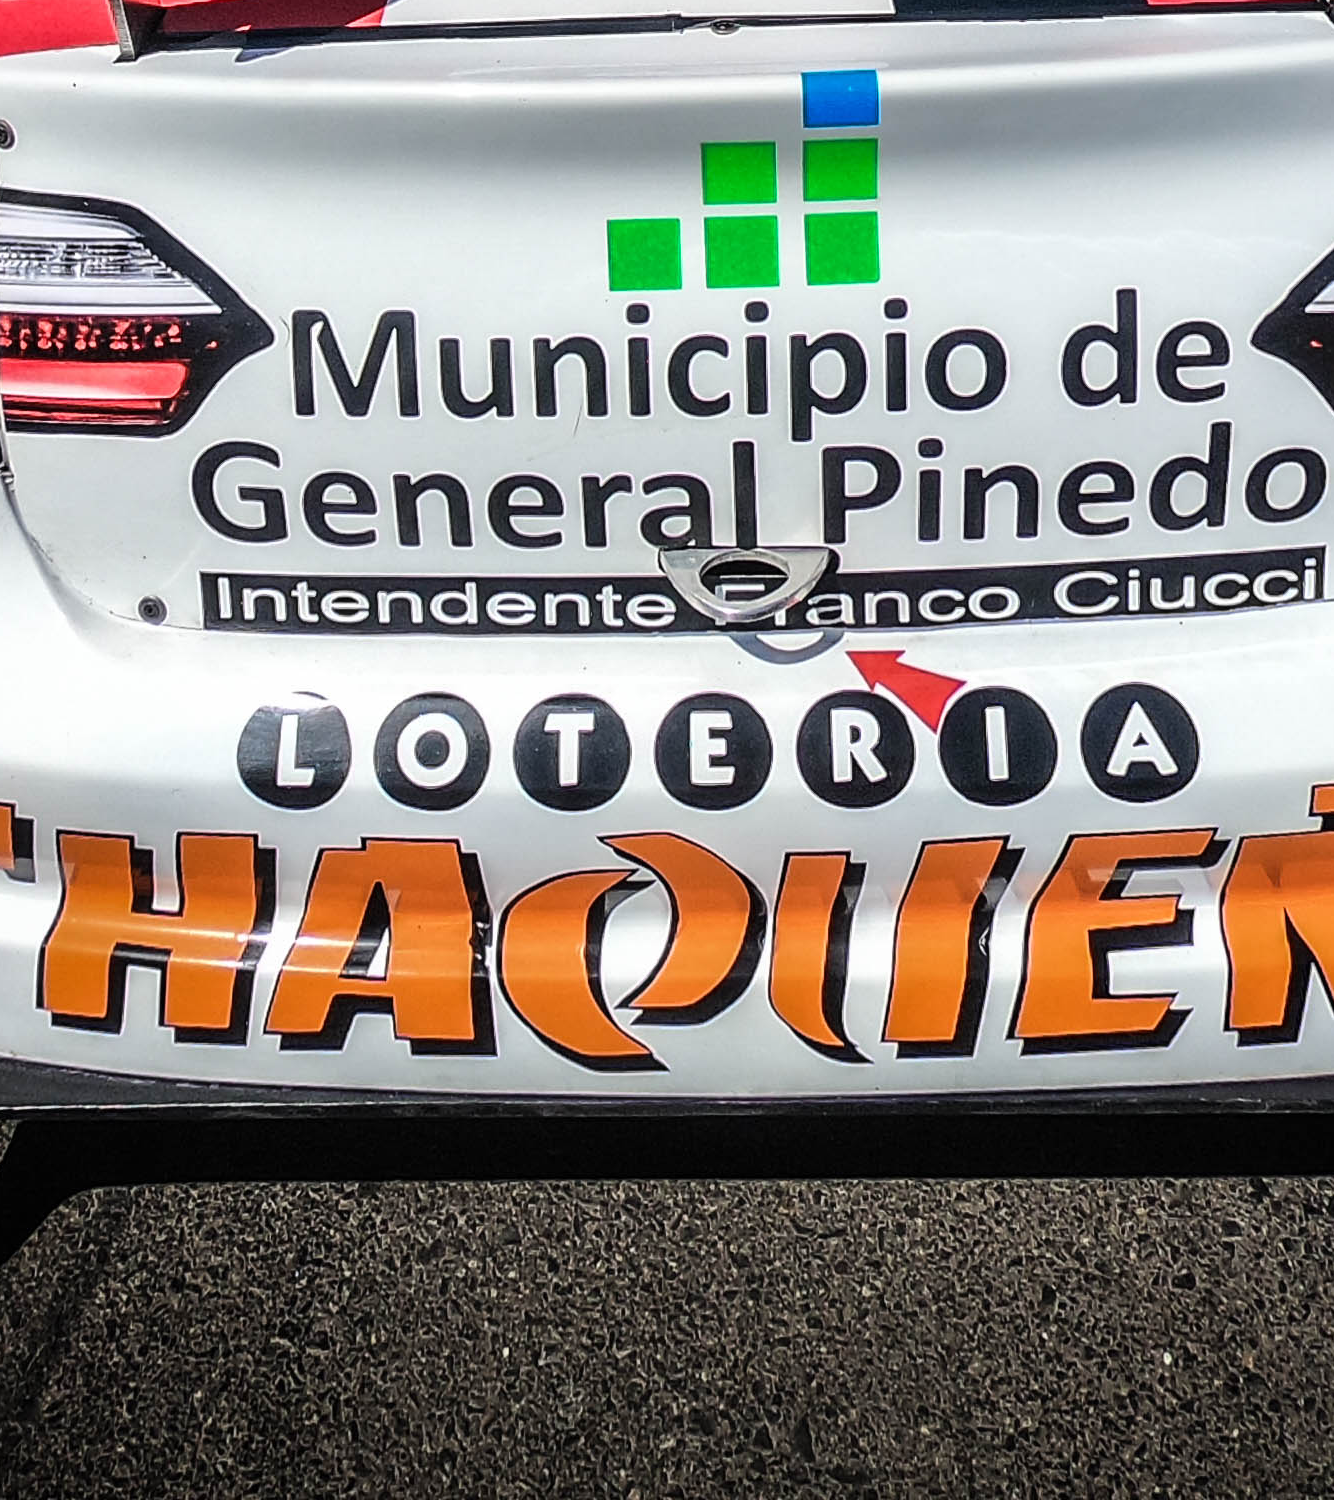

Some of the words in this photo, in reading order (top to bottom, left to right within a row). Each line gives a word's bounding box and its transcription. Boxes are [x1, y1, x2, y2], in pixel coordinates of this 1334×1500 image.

[291, 297, 1009, 442] Municipio
[1063, 287, 1232, 409] de
[191, 438, 757, 552] General
[821, 420, 1328, 547] Pinedo
[216, 575, 677, 628] Intendente
[1053, 557, 1319, 616] Ciucci
[267, 696, 1184, 793] LOTERIA
